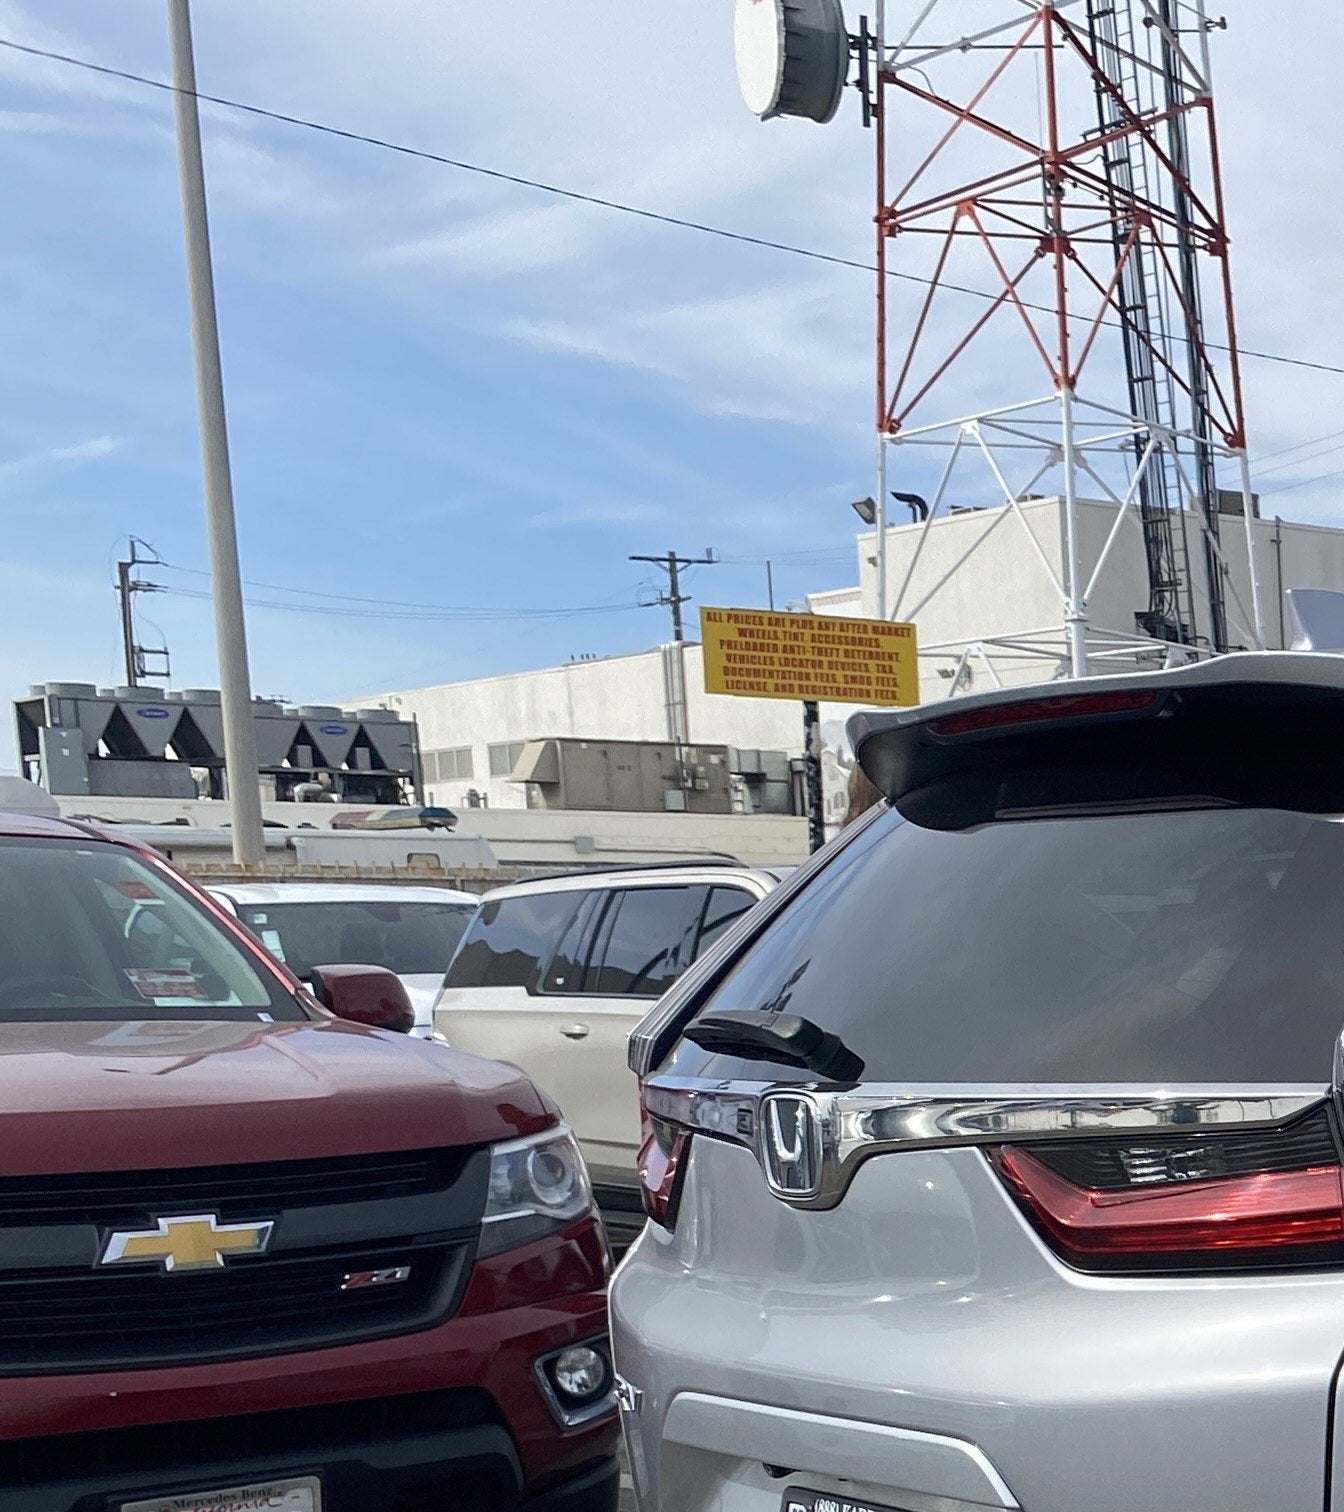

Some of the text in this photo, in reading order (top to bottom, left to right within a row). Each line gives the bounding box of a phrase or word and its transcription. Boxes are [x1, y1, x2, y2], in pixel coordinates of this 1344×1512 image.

[706, 611, 912, 638] ALL PRICES ARE PLUS ANY AFTER MARKET
[719, 639, 779, 653] PRELOADED
[782, 644, 841, 658] ANTI-THEFT
[725, 653, 776, 666] VEHICLES
[778, 656, 825, 670] LOCATOR
[723, 665, 812, 681] DOCUMENTATION
[843, 674, 873, 686] SMOG
[774, 682, 796, 694] AND
[797, 684, 873, 699] REGISTRATION
